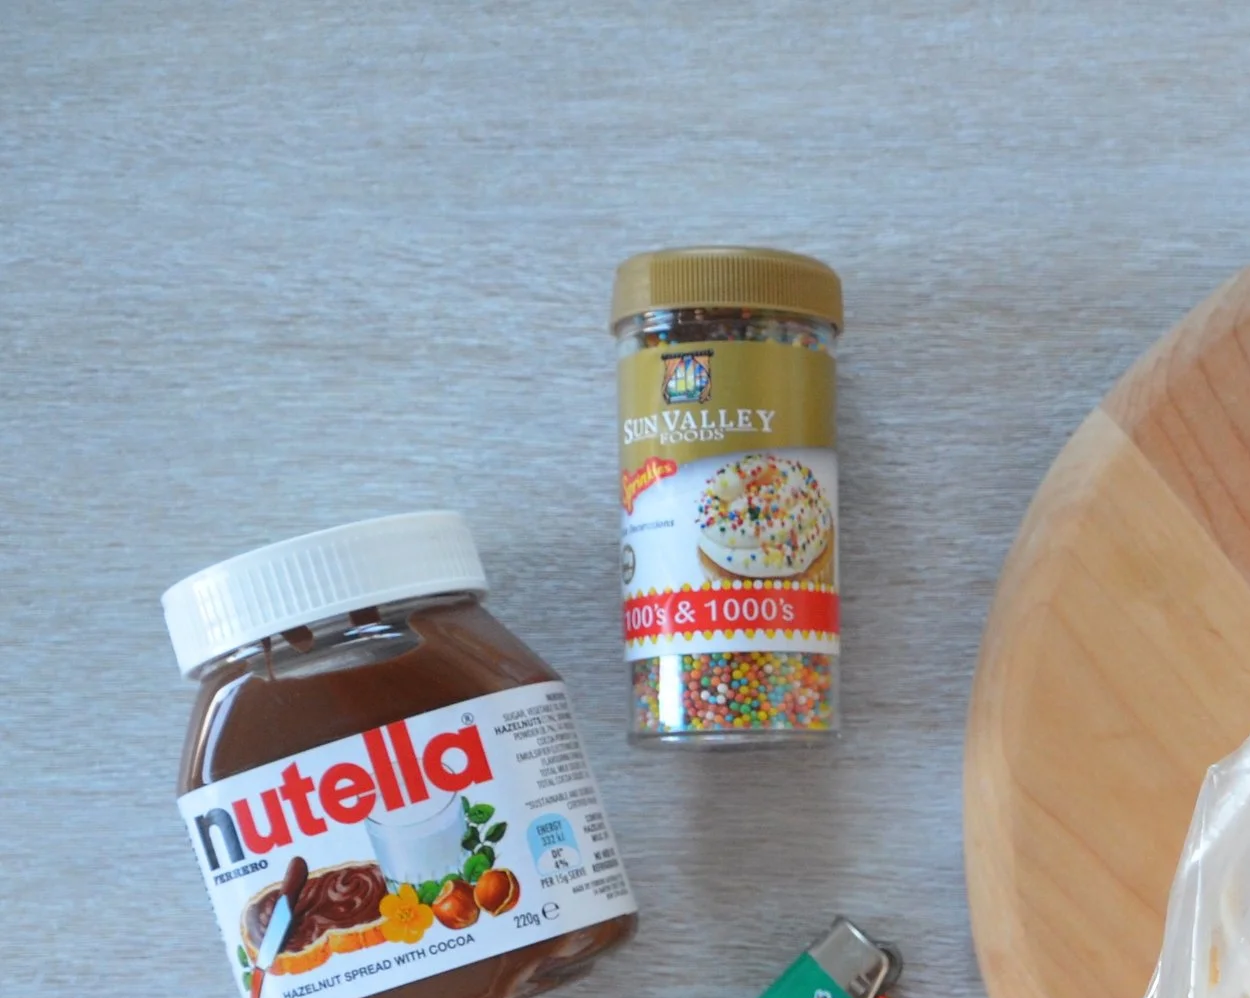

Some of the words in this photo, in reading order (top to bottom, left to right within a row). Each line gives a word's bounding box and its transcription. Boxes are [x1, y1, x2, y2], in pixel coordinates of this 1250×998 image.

[624, 414, 658, 444] SUN
[662, 409, 775, 432] VALLEY
[660, 429, 725, 445] FOODS
[674, 600, 696, 624] &
[704, 598, 795, 622] 1000's
[194, 719, 494, 872] nutella
[536, 820, 562, 835] ENERGY
[213, 859, 268, 886] FERRERO
[540, 877, 555, 889] PER
[513, 911, 541, 928] 220g
[344, 960, 392, 984] SPREAD
[393, 947, 427, 969] WITH
[428, 933, 475, 956] COCOA
